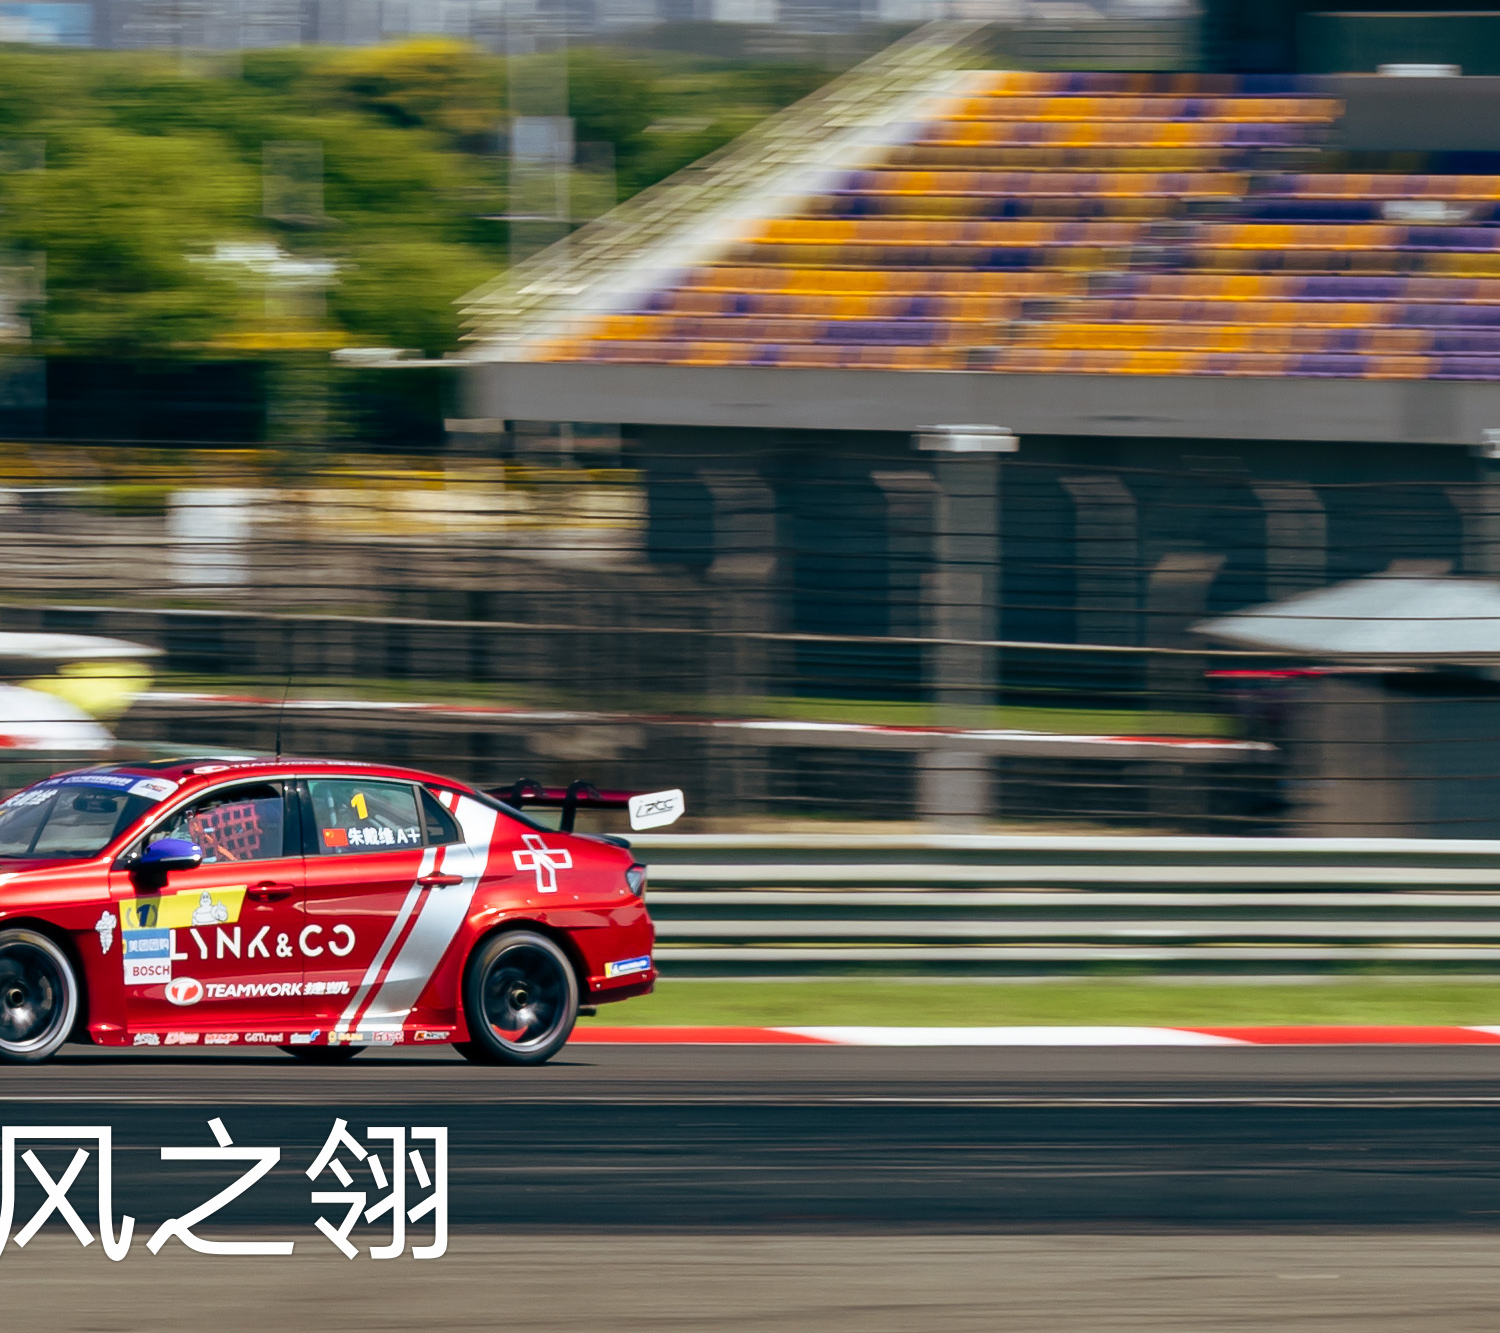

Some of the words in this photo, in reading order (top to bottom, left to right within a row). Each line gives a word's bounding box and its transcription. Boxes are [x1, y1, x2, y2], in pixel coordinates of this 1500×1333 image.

[351, 793, 369, 820] 1
[397, 827, 421, 845] A+
[136, 904, 155, 928] 1
[132, 965, 170, 976] BOSCH
[206, 982, 302, 998] TEAMWORK
